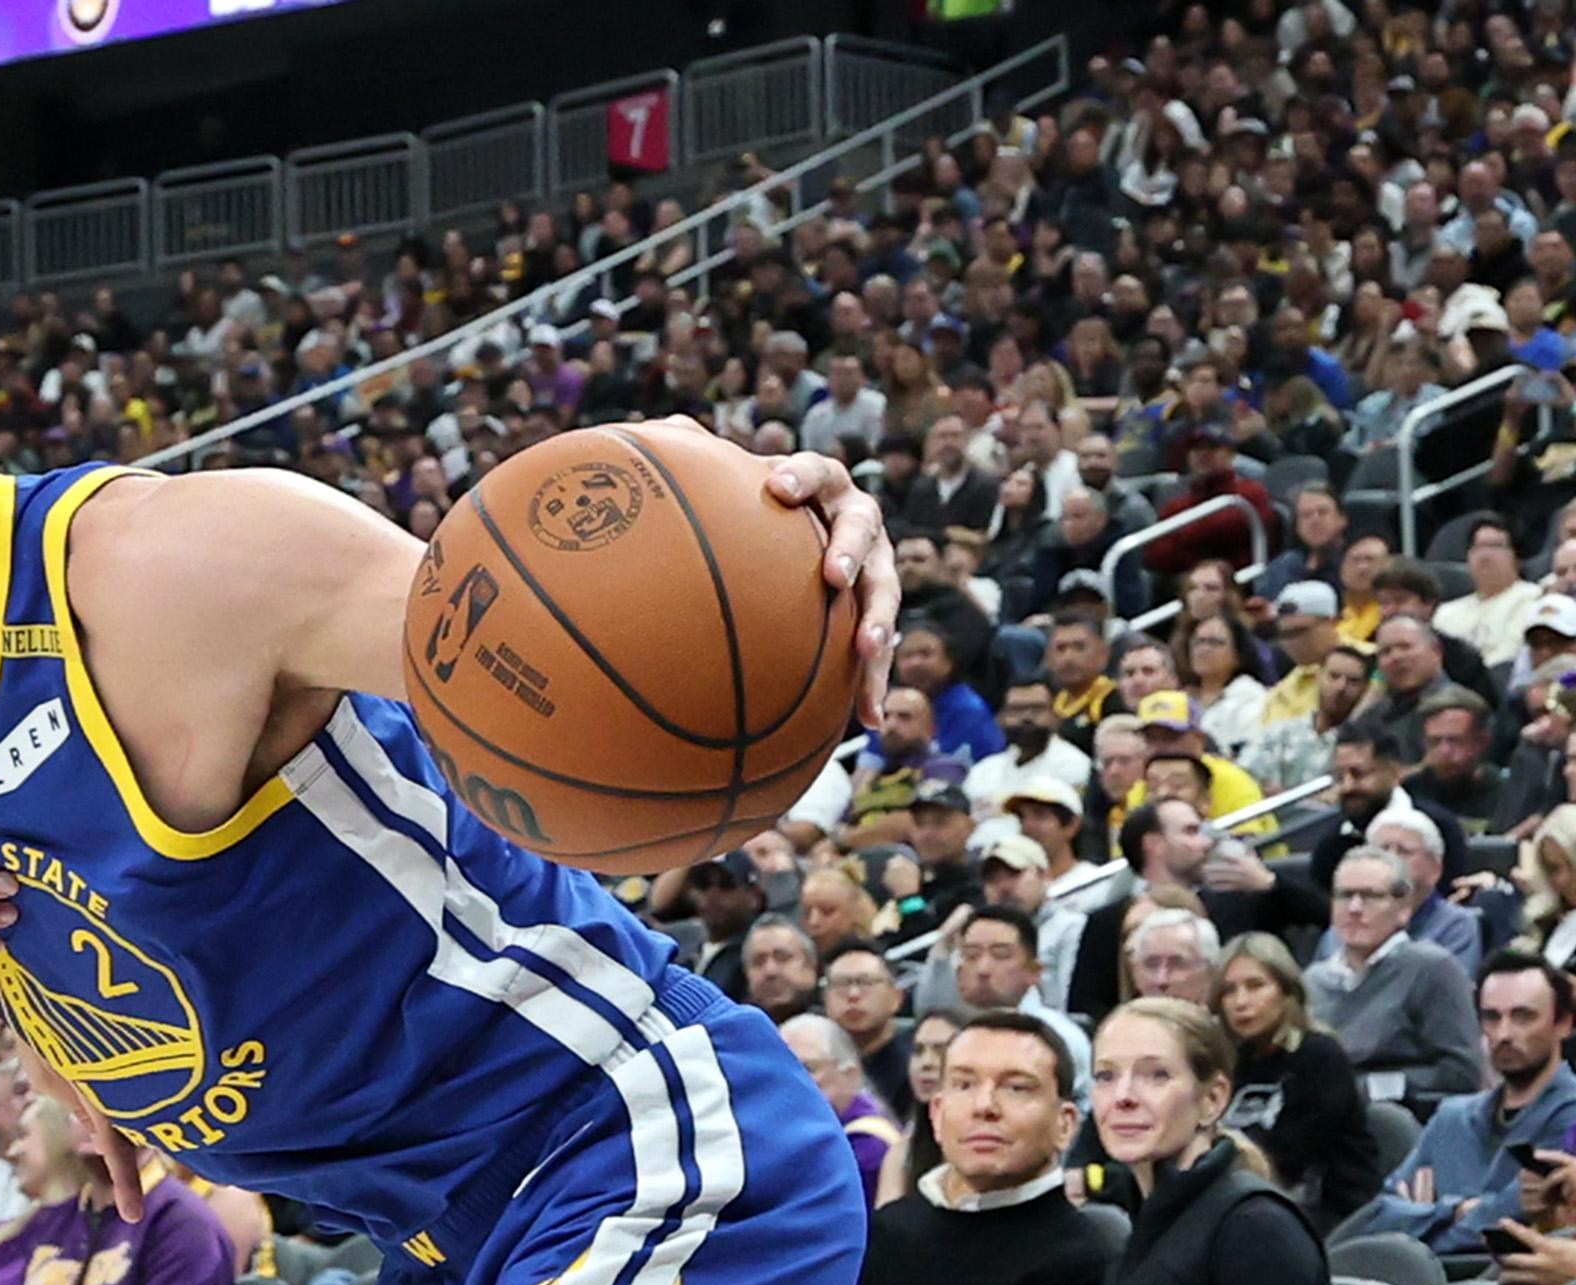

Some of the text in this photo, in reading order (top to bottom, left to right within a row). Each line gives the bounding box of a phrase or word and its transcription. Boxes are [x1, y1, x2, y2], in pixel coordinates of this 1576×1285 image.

[627, 106, 649, 159] 7
[1, 628, 63, 653] NELLIE
[0, 843, 109, 919] STATE
[70, 928, 140, 999] 2
[401, 1229, 447, 1268] W
